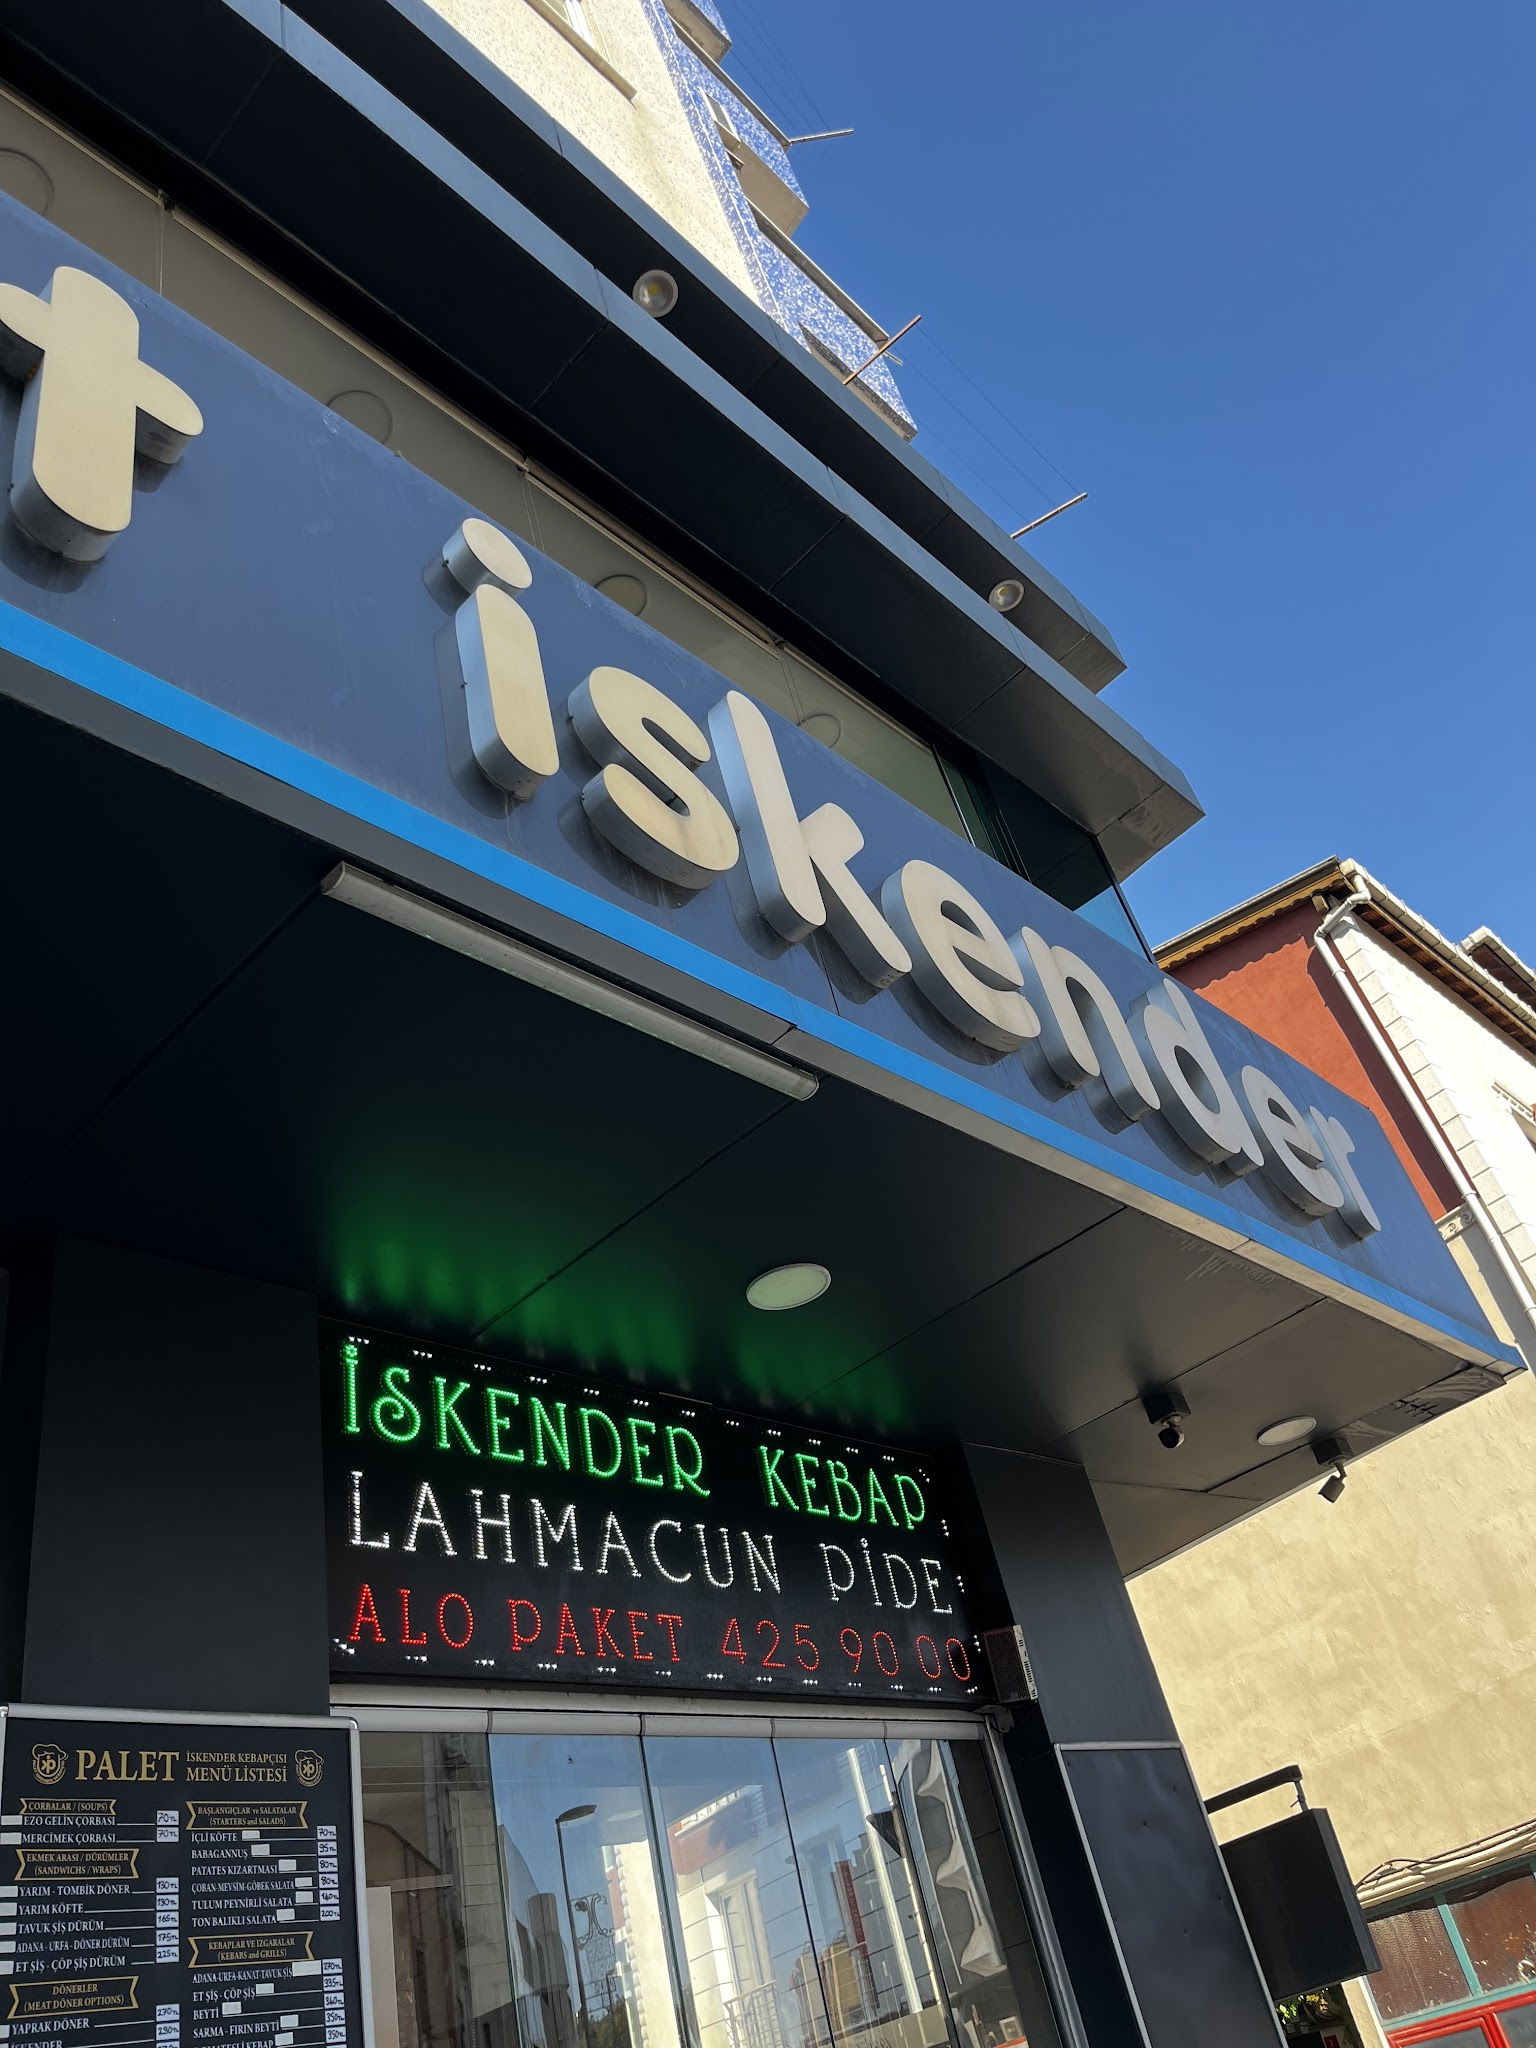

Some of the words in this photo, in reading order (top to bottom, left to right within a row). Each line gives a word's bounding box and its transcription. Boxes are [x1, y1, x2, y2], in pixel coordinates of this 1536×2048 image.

[452, 518, 1381, 1238] iskender
[341, 1338, 711, 1497] İSKENDER
[756, 1443, 928, 1530] KEBAP
[348, 1470, 782, 1595] LAHMACUN
[818, 1537, 954, 1615] PİDE
[347, 1582, 475, 1650] ALO
[508, 1598, 683, 1662] PAKET
[721, 1617, 821, 1672] 425
[839, 1627, 900, 1678] 90
[915, 1634, 972, 1682] 00
[186, 1750, 237, 1763] İSKENDER
[238, 1752, 288, 1766] KEBAPÇISI
[75, 1749, 180, 1782] PALET
[186, 1765, 232, 1782] MENÜ
[235, 1765, 288, 1782] LİSTESİ
[28, 1802, 72, 1812] ÇORBALAR
[77, 1802, 108, 1811] (SOUPS)
[260, 1806, 297, 1815] SALATALAR
[24, 1816, 43, 1826] EZO
[45, 1814, 74, 1826] GELİN
[75, 1815, 115, 1828] ÇORBASI
[209, 1817, 247, 1827] (STARTERS
[258, 1816, 287, 1826] SALADS)
[22, 1831, 74, 1844] MERCİMEK
[76, 1833, 116, 1846] ÇORBASI
[191, 1831, 209, 1843] İÇLİ
[210, 1831, 238, 1842] KÖFTE
[27, 1853, 57, 1862] EKMEK
[57, 1853, 79, 1862] ARASI
[85, 1851, 129, 1862] DÜRÜMLER
[191, 1849, 249, 1860] BABAGANNUŞ
[34, 1865, 86, 1876] (SANDWICHS
[92, 1864, 121, 1875] WRAPS)
[191, 1866, 226, 1876] PATATES
[227, 1864, 278, 1875] KIZARTMASI
[19, 1886, 50, 1897] YARIM
[57, 1883, 96, 1896] TOMBİK
[97, 1883, 130, 1895] DÖNER
[270, 1880, 295, 1890] SALATA
[18, 1904, 50, 1916] YARIM
[51, 1902, 84, 1915] KÖFTE
[191, 1899, 223, 1910] TULUM
[224, 1896, 262, 1909] PEYNİRLİ
[263, 1897, 293, 1907] SALATA
[18, 1923, 50, 1934] TAVUK
[51, 1921, 66, 1935] ŞİŞ
[68, 1919, 104, 1932] DÜRÜM
[192, 1917, 211, 1928] TON
[212, 1915, 245, 1927] BALIKLI
[246, 1914, 277, 1925] SALATA
[16, 1941, 44, 1953] ADANA
[49, 1940, 70, 1951] URFA
[73, 1938, 101, 1950] DÖNER
[102, 1936, 130, 1949] DÜRÜM
[208, 1939, 246, 1950] KEBAPLAR
[247, 1939, 256, 1948] VE
[256, 1937, 295, 1947] IZGARALAR
[218, 1951, 247, 1962] (KEBABS
[260, 1949, 287, 1960] GRILLS)
[15, 1962, 28, 1973] ET
[30, 1959, 45, 1974] ŞİŞ
[51, 1957, 71, 1973] ÇÖP
[74, 1957, 88, 1971] ŞİŞ
[89, 1955, 126, 1968] DÜRÜM
[53, 1983, 98, 1995] DÖNERLER
[193, 1992, 204, 2002] ET
[205, 1989, 219, 2004] ŞİŞ
[224, 1987, 241, 2003] ÇÖP
[243, 1987, 256, 2001] ŞİŞ
[24, 2000, 51, 2013] (MEAT
[52, 1997, 84, 2010] DÖNER
[84, 1994, 125, 2007] OPTIONS)
[193, 2007, 219, 2021] BEYTİ
[12, 2022, 52, 2036] YAPRAK
[53, 2017, 90, 2031] DÖNER
[193, 2026, 224, 2039] SARMA
[229, 2024, 254, 2037] FIRIN
[255, 2020, 280, 2034] BEYTİ
